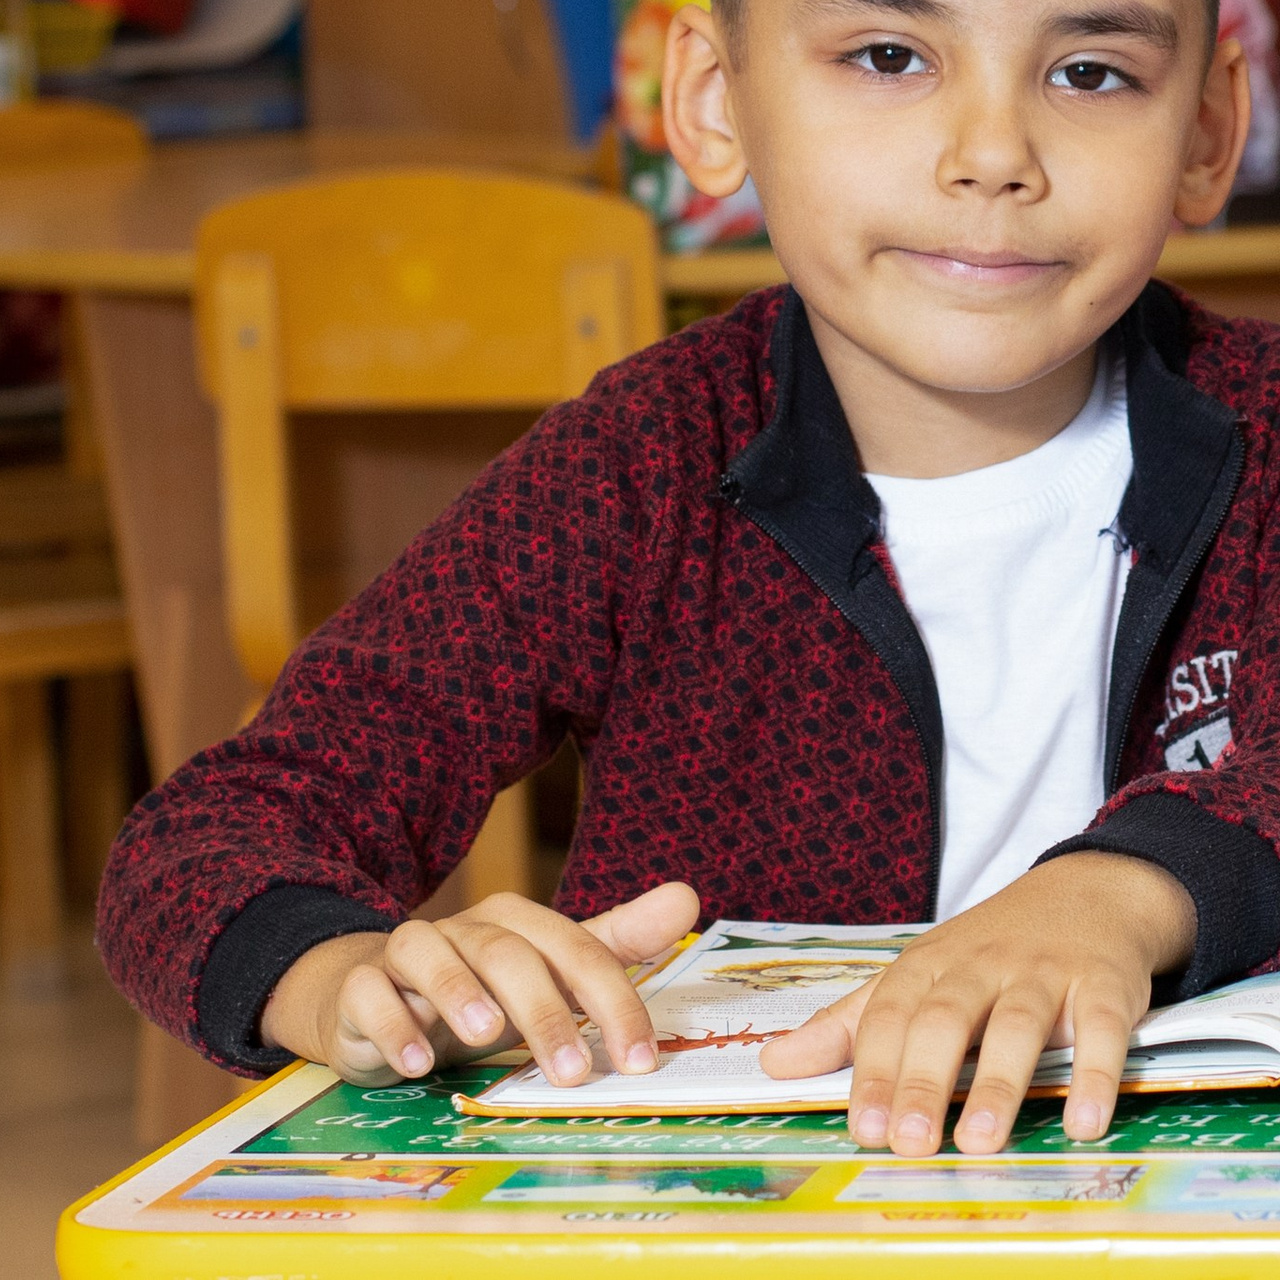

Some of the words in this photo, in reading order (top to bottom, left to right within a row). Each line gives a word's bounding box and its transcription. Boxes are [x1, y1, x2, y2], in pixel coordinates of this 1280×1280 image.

[1163, 650, 1238, 728] SIT
[314, 1112, 413, 1127] Рр
[407, 1134, 495, 1147] Зз
[511, 1133, 671, 1146] Жж
[678, 1134, 786, 1149] Ёё
[1148, 1132, 1252, 1146] Вв
[212, 1209, 355, 1220] ОСЕНЬ
[562, 1211, 676, 1222] ЛЕТО
